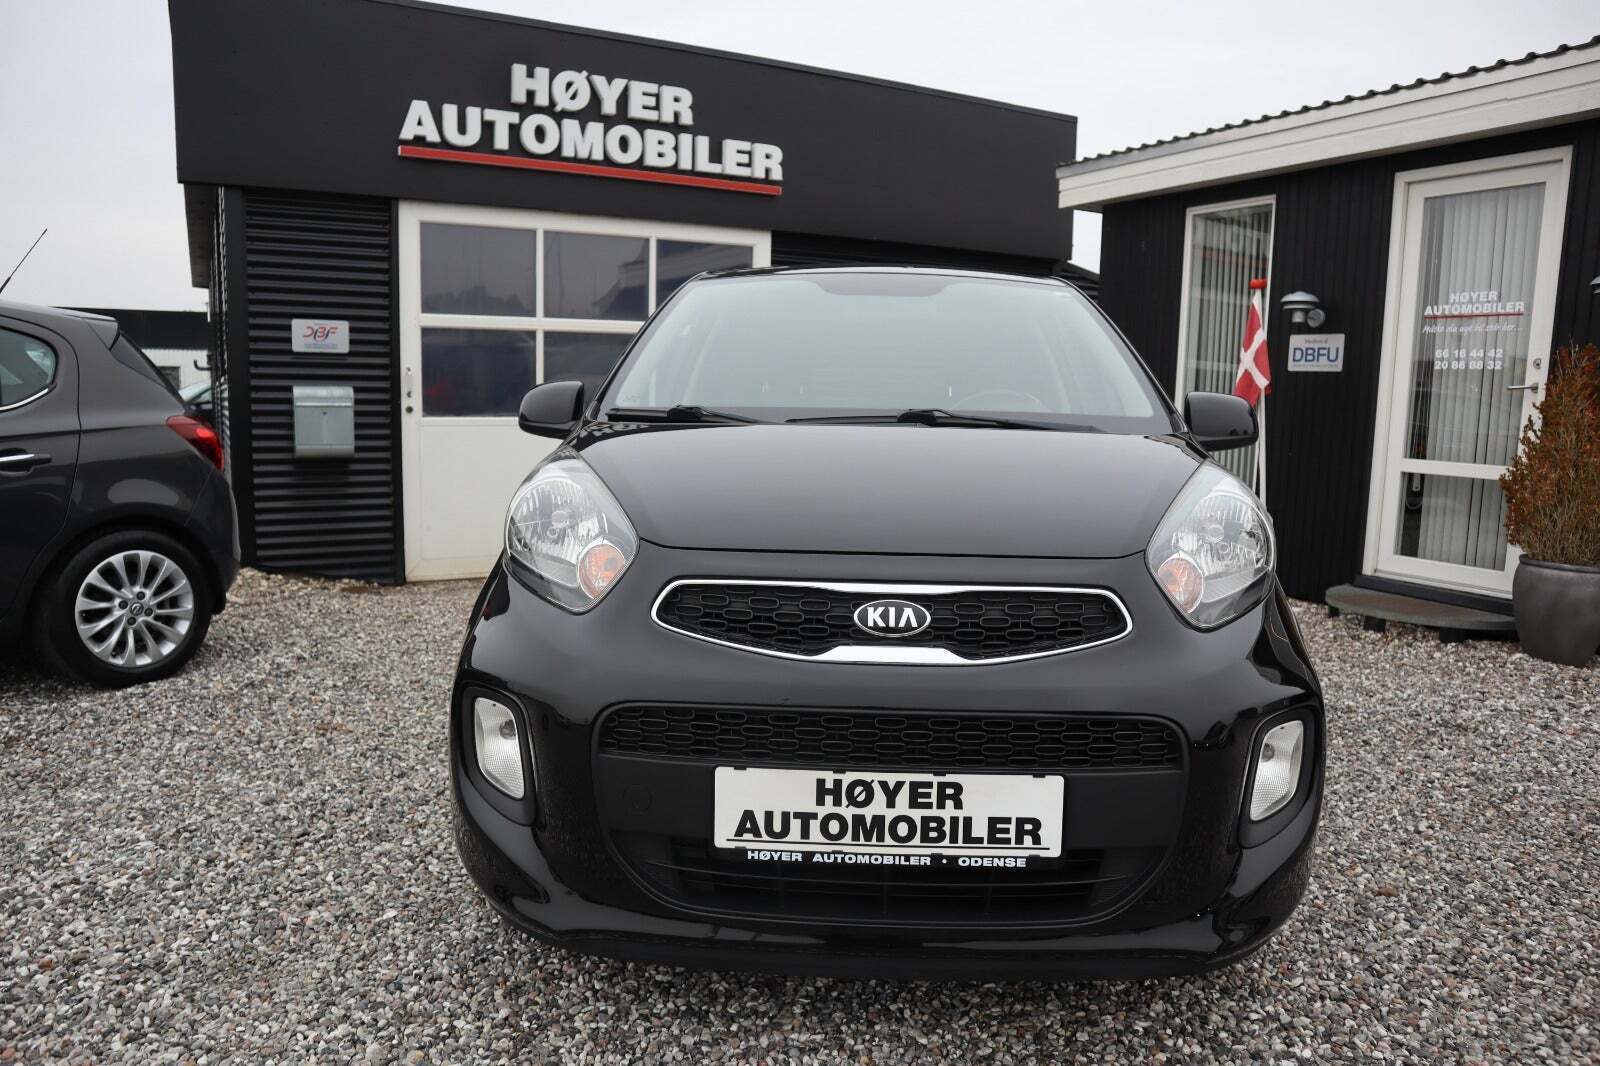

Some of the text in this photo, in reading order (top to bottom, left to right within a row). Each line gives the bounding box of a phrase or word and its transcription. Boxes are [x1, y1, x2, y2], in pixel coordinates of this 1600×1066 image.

[511, 63, 694, 126] HØYER
[400, 99, 784, 181] AUTOMOBILER
[1424, 302, 1525, 315] AUTOMOBILER
[1293, 347, 1339, 363] DBFU
[1469, 349, 1484, 358] 44
[1487, 349, 1503, 358] 42
[1434, 361, 1449, 370] 20
[1486, 361, 1502, 370] 32
[866, 606, 918, 628] KIA
[816, 778, 964, 810] HØYER
[734, 809, 1042, 846] AUTOMOBILER
[747, 850, 1027, 868] HØYER AUTOMOBILER ODENSE
